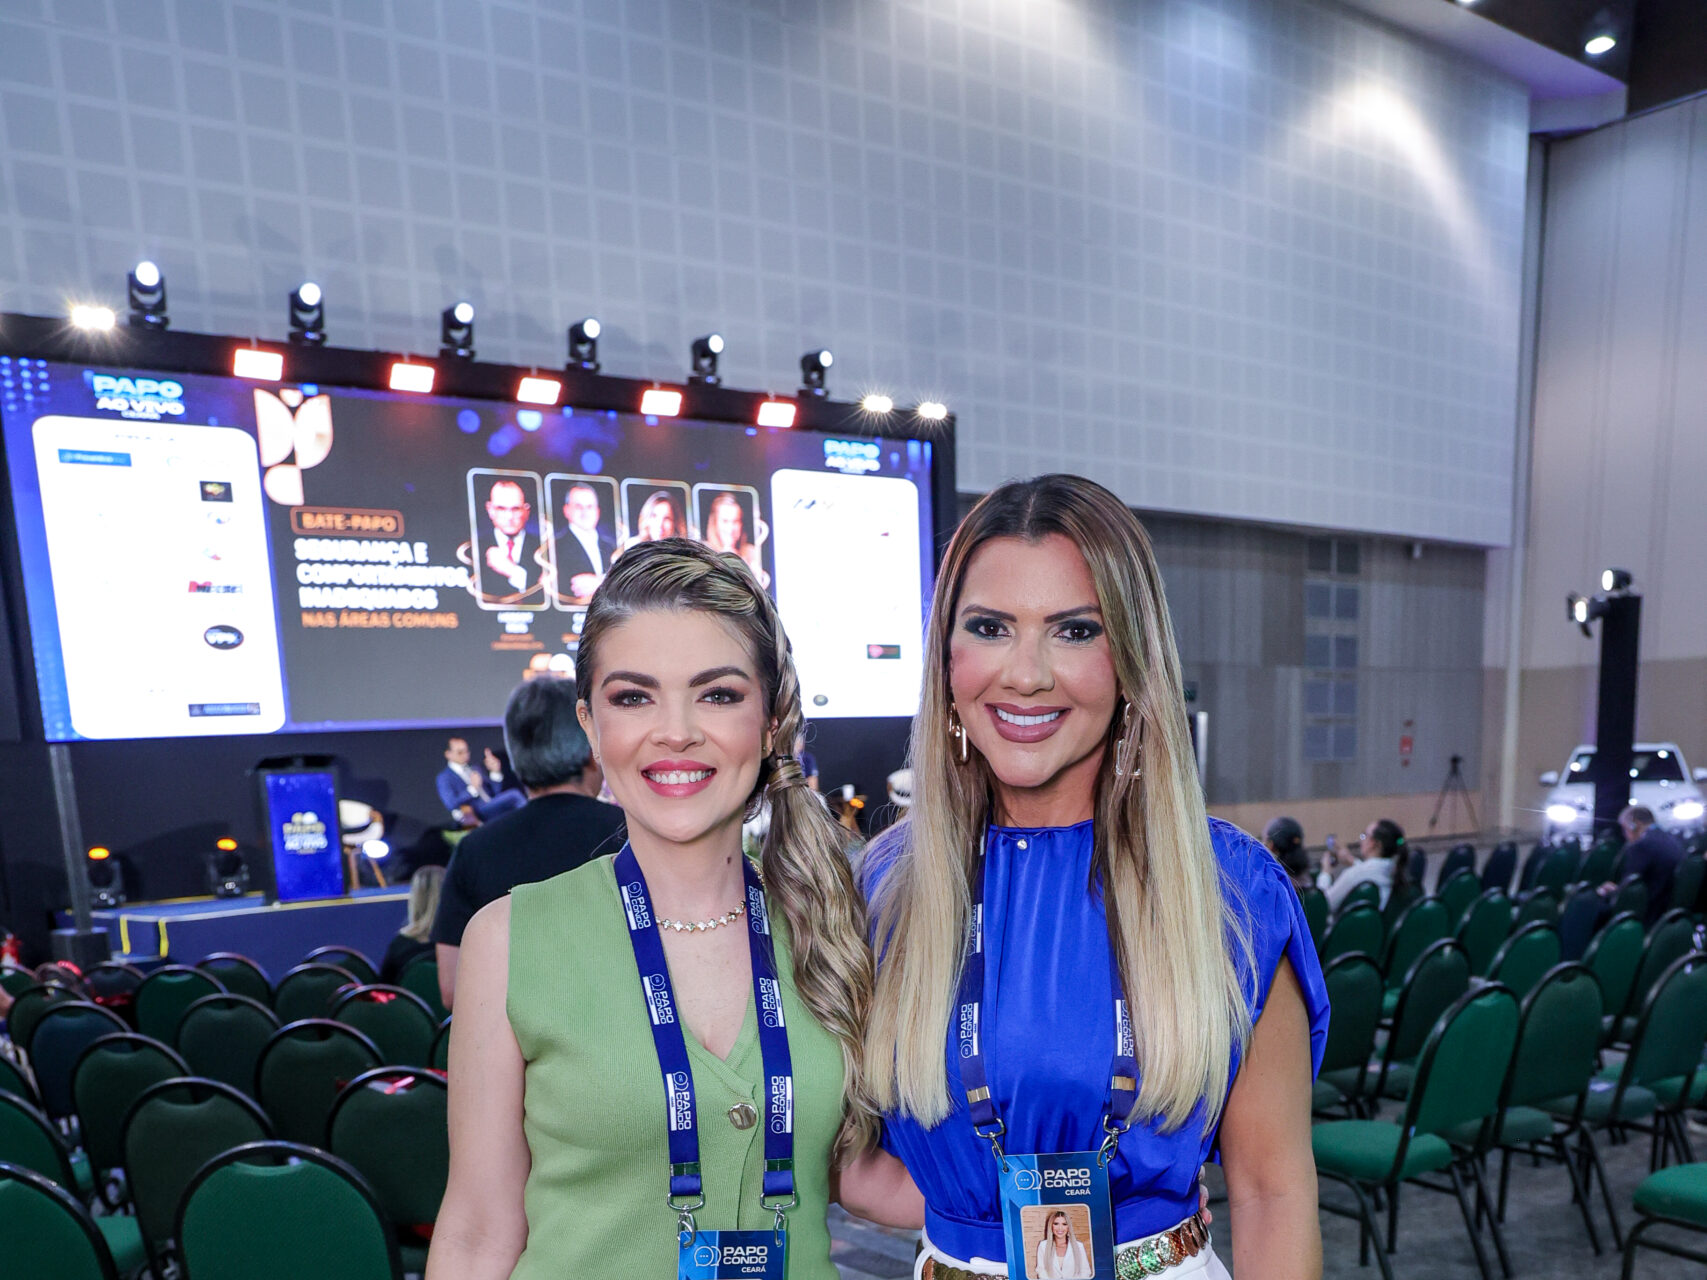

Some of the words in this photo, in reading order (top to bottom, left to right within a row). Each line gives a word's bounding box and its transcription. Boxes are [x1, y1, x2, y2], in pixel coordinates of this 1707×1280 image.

[93, 375, 183, 398] PAPO
[96, 397, 129, 411] AO
[130, 400, 185, 415] VIVO
[302, 512, 397, 532] BATE-PAPO
[294, 538, 413, 568] SEGURANÇA
[413, 542, 429, 564] E
[301, 611, 337, 628] NAS
[338, 609, 391, 629] ÁREAS
[392, 612, 459, 629] COMUNS
[631, 899, 644, 929] CONDO
[637, 896, 651, 928] PAPO
[653, 992, 667, 1025] CONDO
[660, 990, 675, 1024] PAPO
[759, 977, 770, 1010] PAPO
[765, 978, 776, 1010] CONDO
[960, 1004, 968, 1039] PAPO
[771, 1076, 780, 1114] PAPO
[778, 1076, 786, 1114] CONDO
[676, 1092, 684, 1130] CONDO
[682, 1091, 692, 1130] PAPO
[1043, 1168, 1091, 1179] PAPO
[1044, 1179, 1091, 1188] CONDO
[1065, 1187, 1091, 1196] CEARÁ
[723, 1246, 768, 1257] PAPO
[723, 1256, 768, 1265] CONDO
[741, 1265, 766, 1273] CEARÁ
